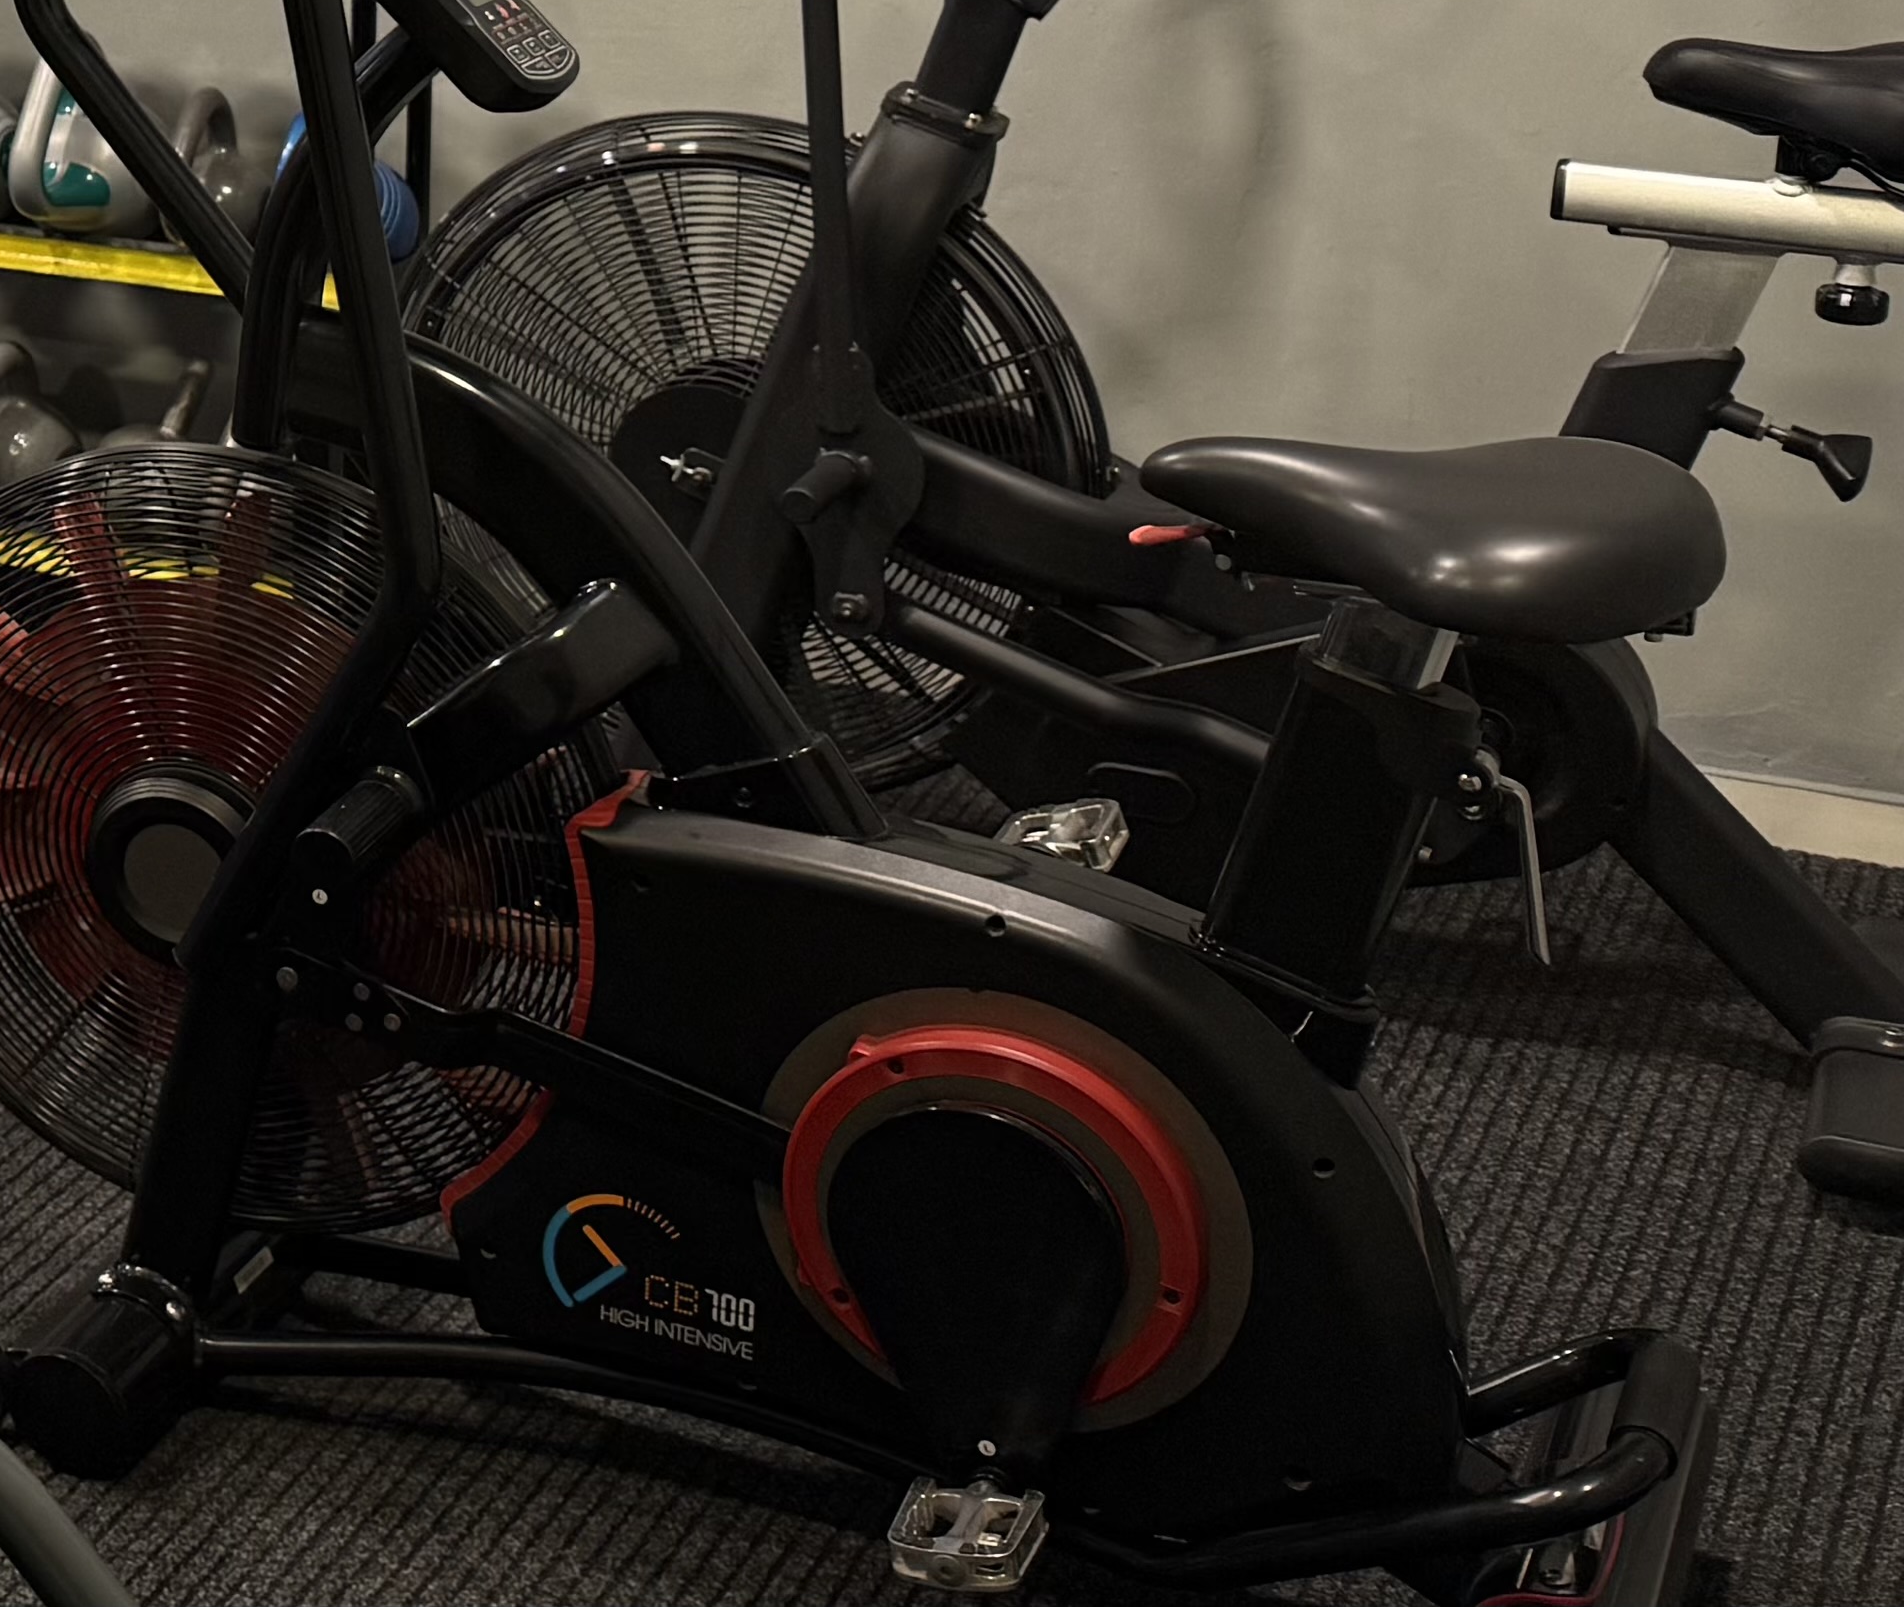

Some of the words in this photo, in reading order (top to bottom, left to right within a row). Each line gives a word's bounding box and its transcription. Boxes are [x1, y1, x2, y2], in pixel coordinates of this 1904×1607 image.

[599, 1303, 650, 1333] HIGH
[653, 1315, 755, 1361] INTENSIVE
[704, 1287, 756, 1332] 700
